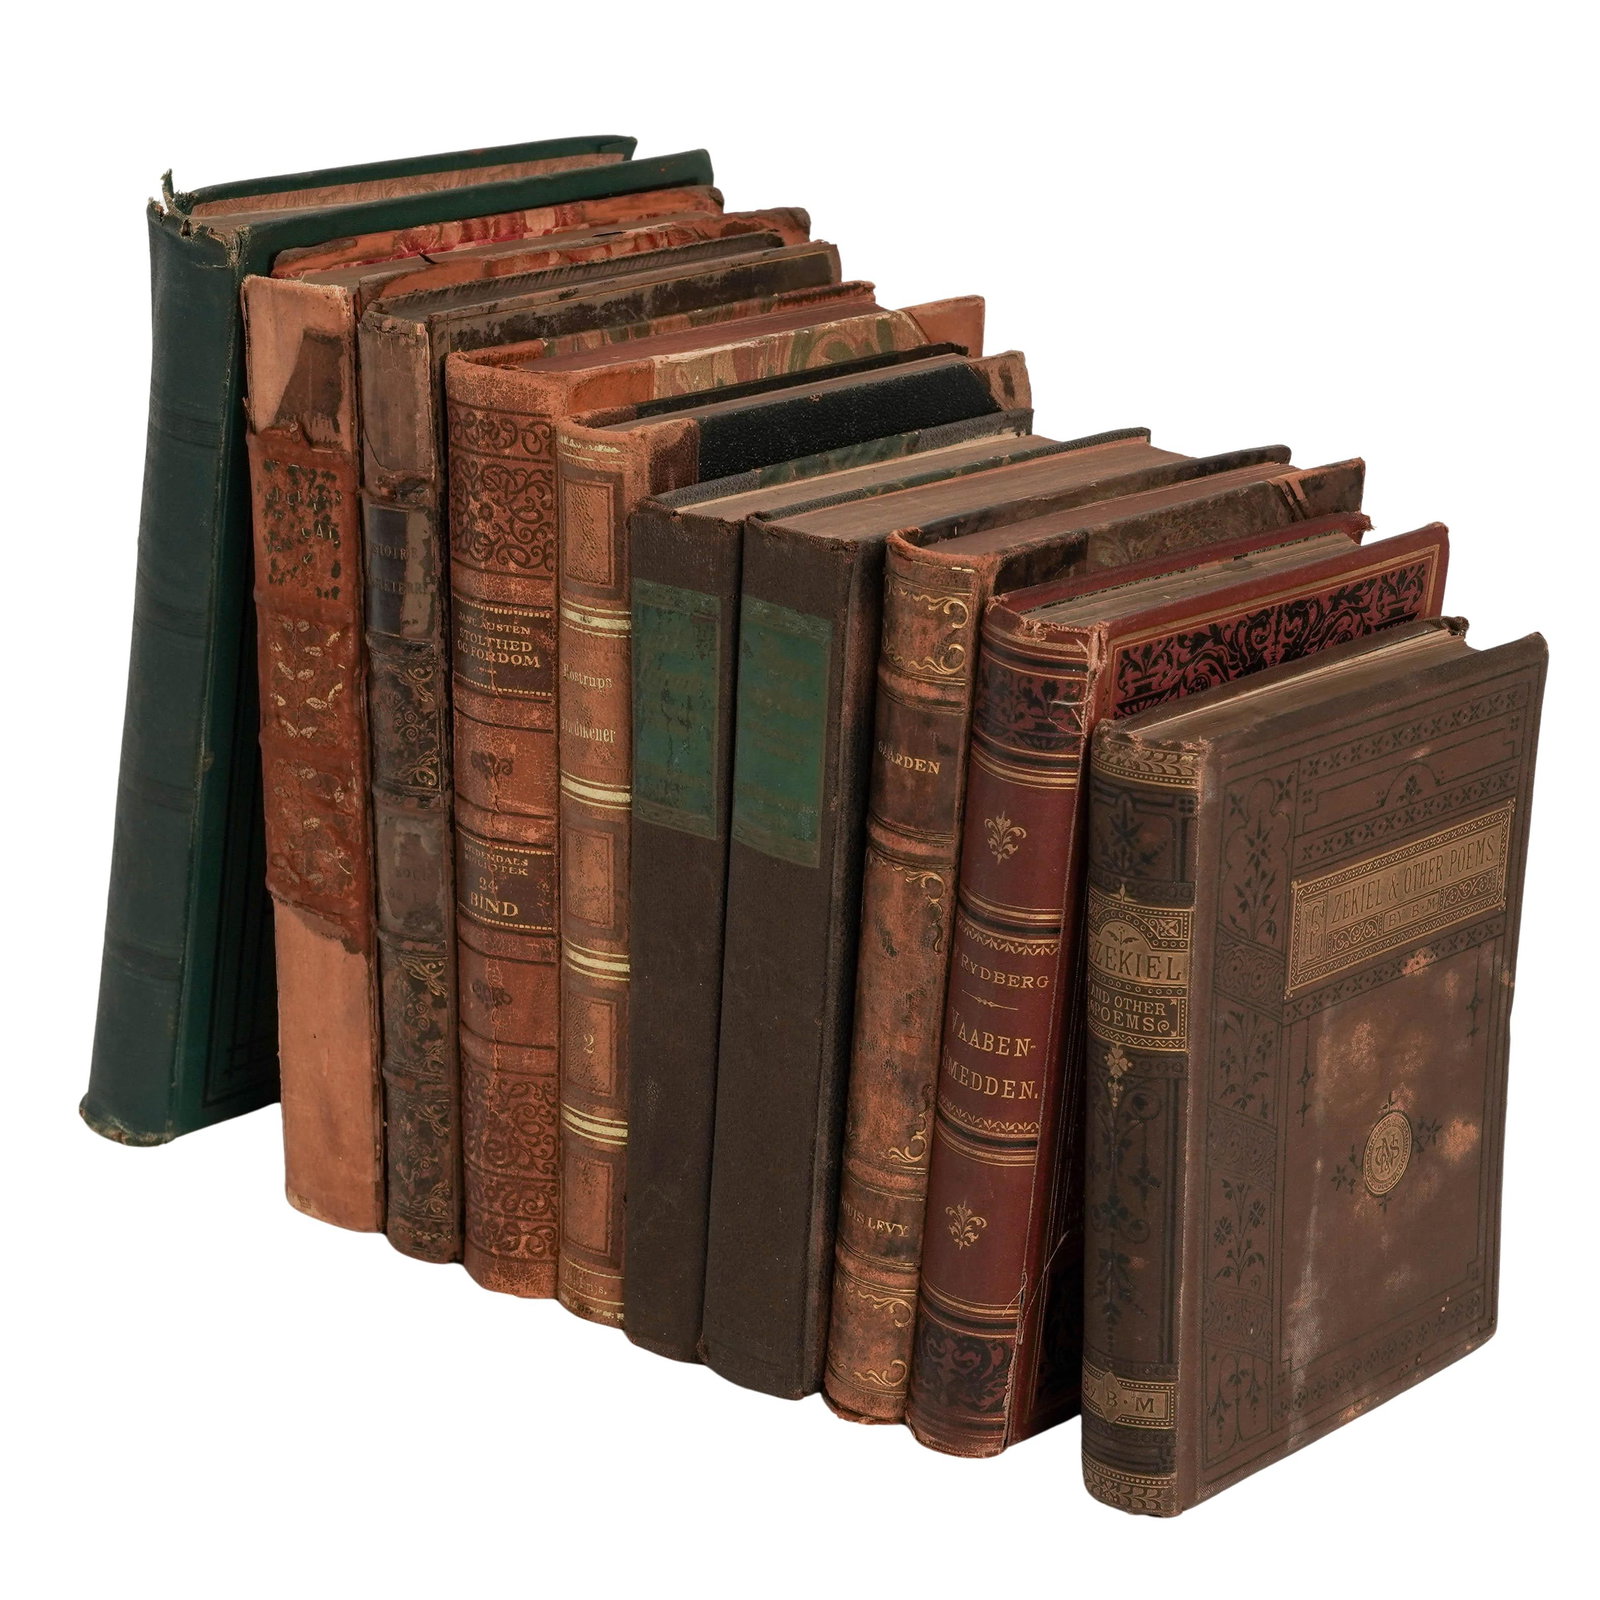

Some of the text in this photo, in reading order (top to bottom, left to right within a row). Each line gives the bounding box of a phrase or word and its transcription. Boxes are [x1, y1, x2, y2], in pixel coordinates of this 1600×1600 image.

[459, 627, 533, 652] STOLTHED
[480, 619, 531, 635] AUSTEN
[457, 639, 541, 668] OG FORDOM
[1388, 873, 1399, 900] &
[1404, 854, 1444, 894] OTHER
[470, 892, 519, 917] BIND
[1388, 909, 1403, 927] BY
[960, 953, 1049, 988] RYDBERG
[1090, 983, 1166, 1016] AND OTHER
[1093, 1003, 1155, 1032] POEMS
[583, 1034, 595, 1054] 2
[867, 1217, 909, 1237] LEVY
